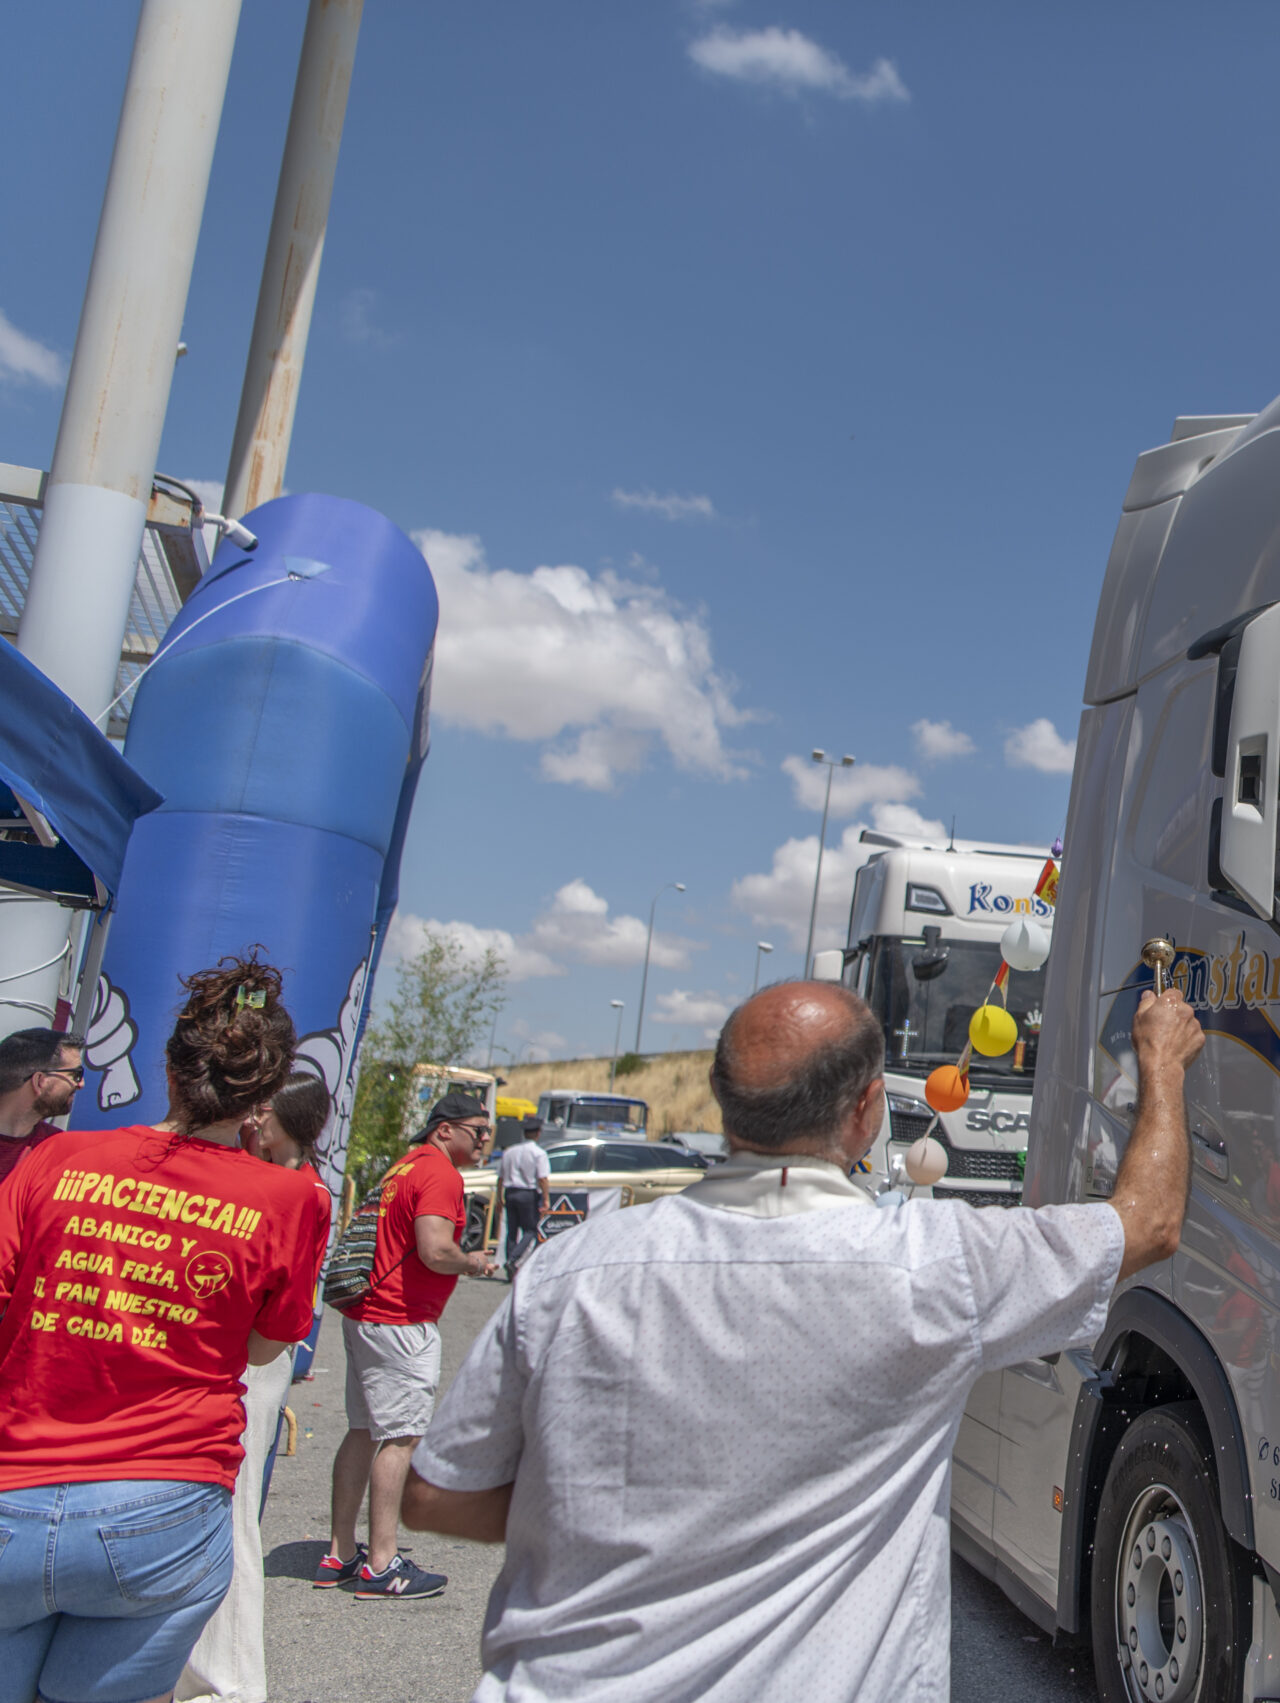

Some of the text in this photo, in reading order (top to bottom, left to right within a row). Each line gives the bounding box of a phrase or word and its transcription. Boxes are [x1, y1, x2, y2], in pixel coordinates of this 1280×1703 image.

[64, 1216, 197, 1257] ABANICO Y
[55, 1249, 179, 1292] AGUA FRÍA,
[54, 1282, 100, 1306] PAN
[104, 1290, 199, 1325] NUESTRO
[30, 1311, 167, 1349] DE CADA DÍA
